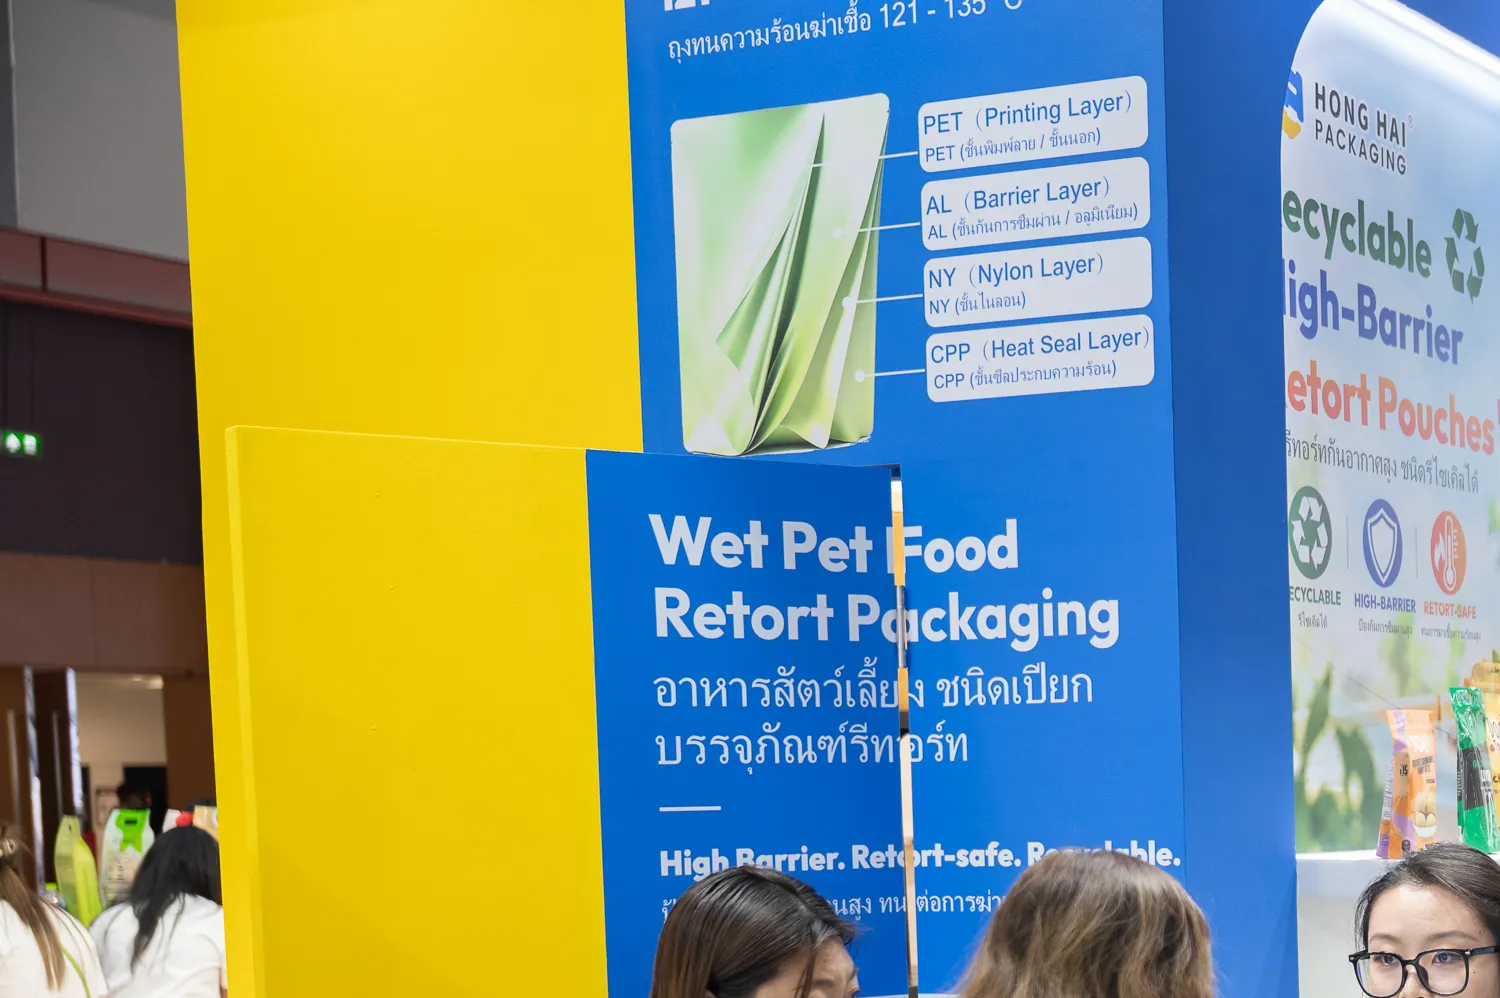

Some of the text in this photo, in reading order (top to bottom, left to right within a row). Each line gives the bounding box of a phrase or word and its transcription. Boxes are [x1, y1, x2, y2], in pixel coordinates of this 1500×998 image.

[880, 0, 919, 29] 121
[1315, 82, 1369, 132] HONG
[924, 112, 964, 135] PET
[925, 145, 956, 162] PET
[1315, 119, 1408, 175] PACKAGING
[926, 196, 953, 215] AL
[928, 224, 948, 240] AL
[1282, 190, 1433, 278] ecyclable
[929, 268, 957, 289] NY
[929, 299, 950, 314] NY
[931, 342, 971, 364] CPP
[1041, 332, 1081, 354] Seal
[934, 373, 965, 389] CPP
[1285, 360, 1495, 456] etort Pouches
[648, 514, 1018, 574] Wet Pet Food
[1289, 585, 1341, 606] ECYCLABLE
[1354, 593, 1416, 613] HIGH-BARRIER
[655, 586, 1120, 653] Retort Packaging
[1424, 601, 1477, 619] RETORT-SAFE
[653, 656, 1093, 709] อาหารสัตว์เลี้ยง ชนิดเปียก
[660, 848, 728, 881] High
